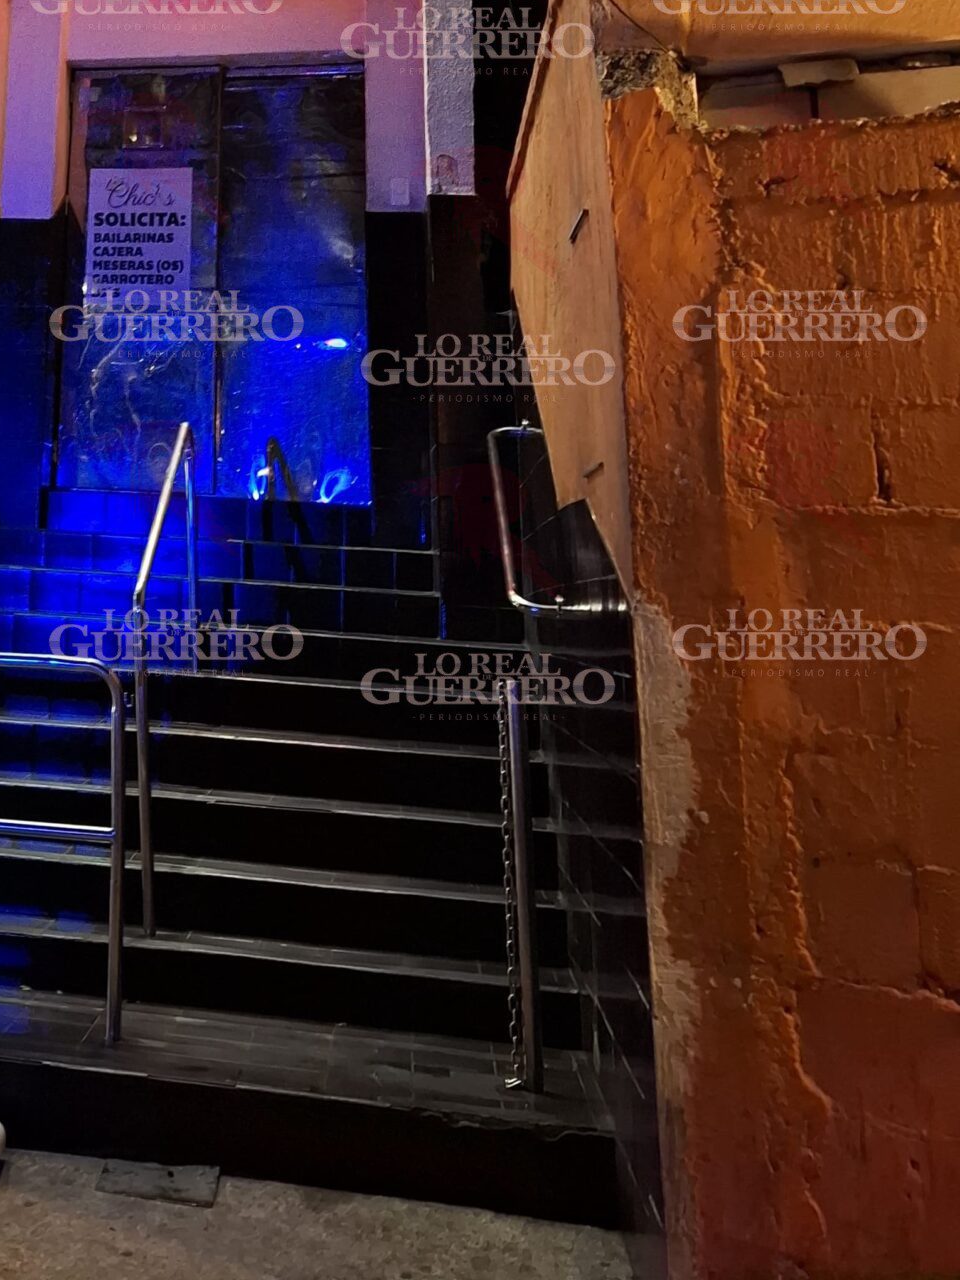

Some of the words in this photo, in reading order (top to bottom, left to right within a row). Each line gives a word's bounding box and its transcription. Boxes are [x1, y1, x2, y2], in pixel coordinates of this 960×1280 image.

[93, 212, 187, 227] SOLICITA:
[93, 232, 175, 244] BAILARINAS
[92, 246, 144, 257] CAJERA
[92, 260, 155, 271] MESERAS
[156, 259, 185, 274] (OS)
